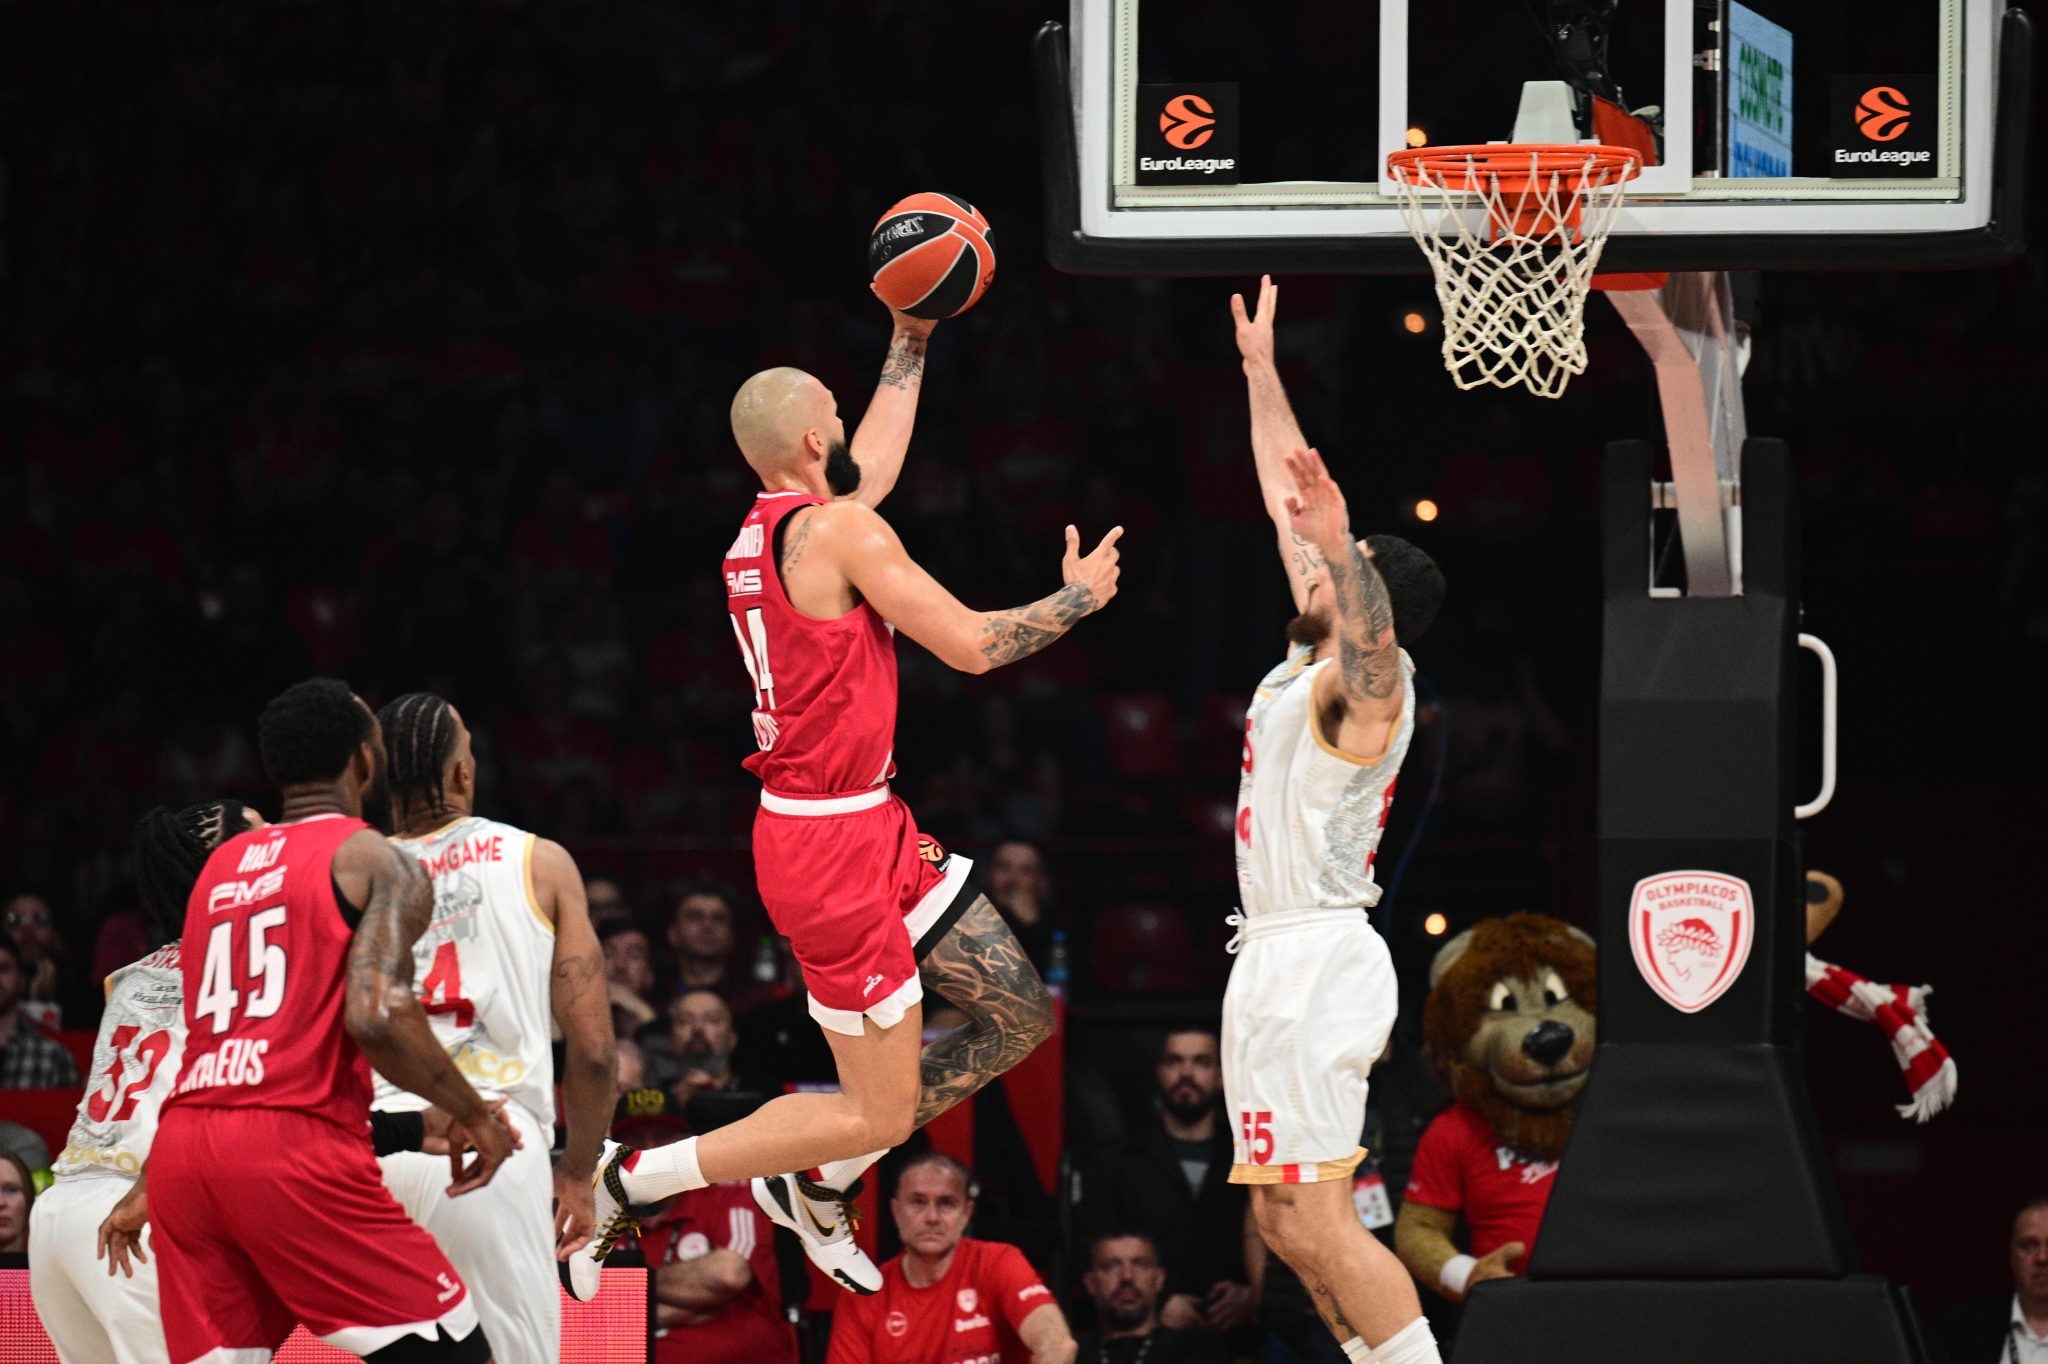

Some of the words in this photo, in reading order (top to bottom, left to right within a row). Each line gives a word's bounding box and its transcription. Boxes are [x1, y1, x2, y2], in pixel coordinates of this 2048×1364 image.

[1140, 157, 1236, 175] EuroLeague
[1833, 149, 1931, 167] EuroLeague
[1645, 882, 1738, 902] OLYMPIACOS
[1659, 898, 1725, 912] BASKETBALL
[195, 904, 287, 1036] 45
[418, 940, 477, 1029] 4
[88, 1024, 171, 1123] 32
